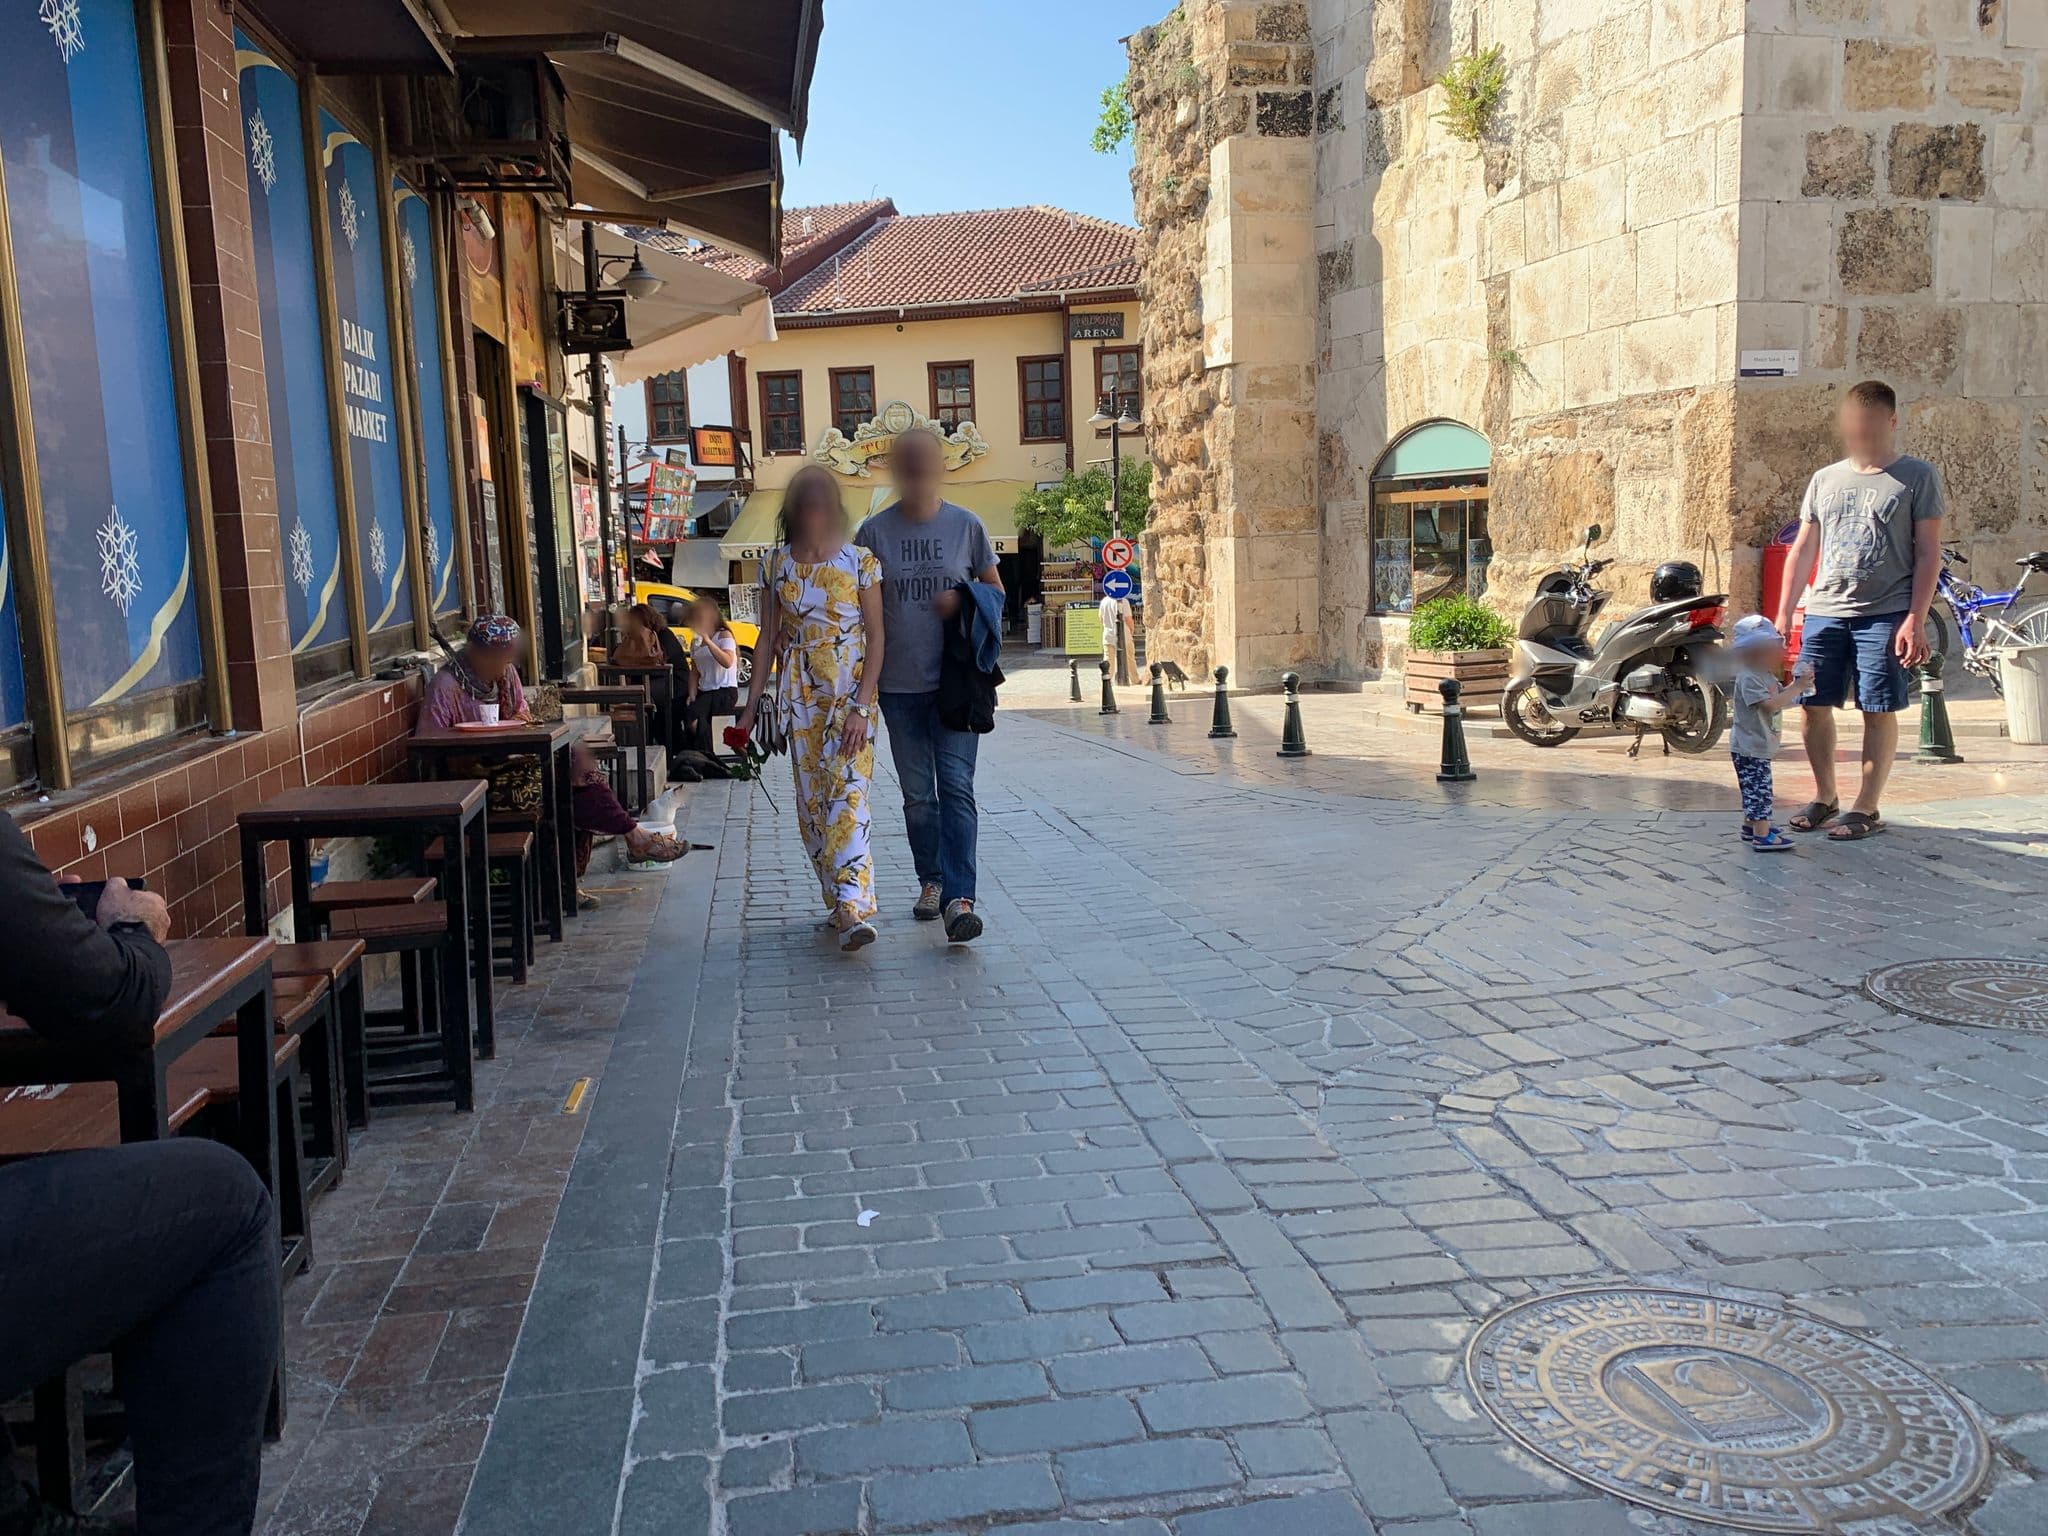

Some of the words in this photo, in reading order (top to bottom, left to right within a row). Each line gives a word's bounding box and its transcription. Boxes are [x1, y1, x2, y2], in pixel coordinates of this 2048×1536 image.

[342, 319, 376, 361] BALIK
[1074, 328, 1117, 338] ARENA
[343, 361, 382, 402] PAZARI
[344, 404, 387, 443] MARKET
[1822, 487, 1900, 525] ZERO
[901, 538, 943, 561] HIKE
